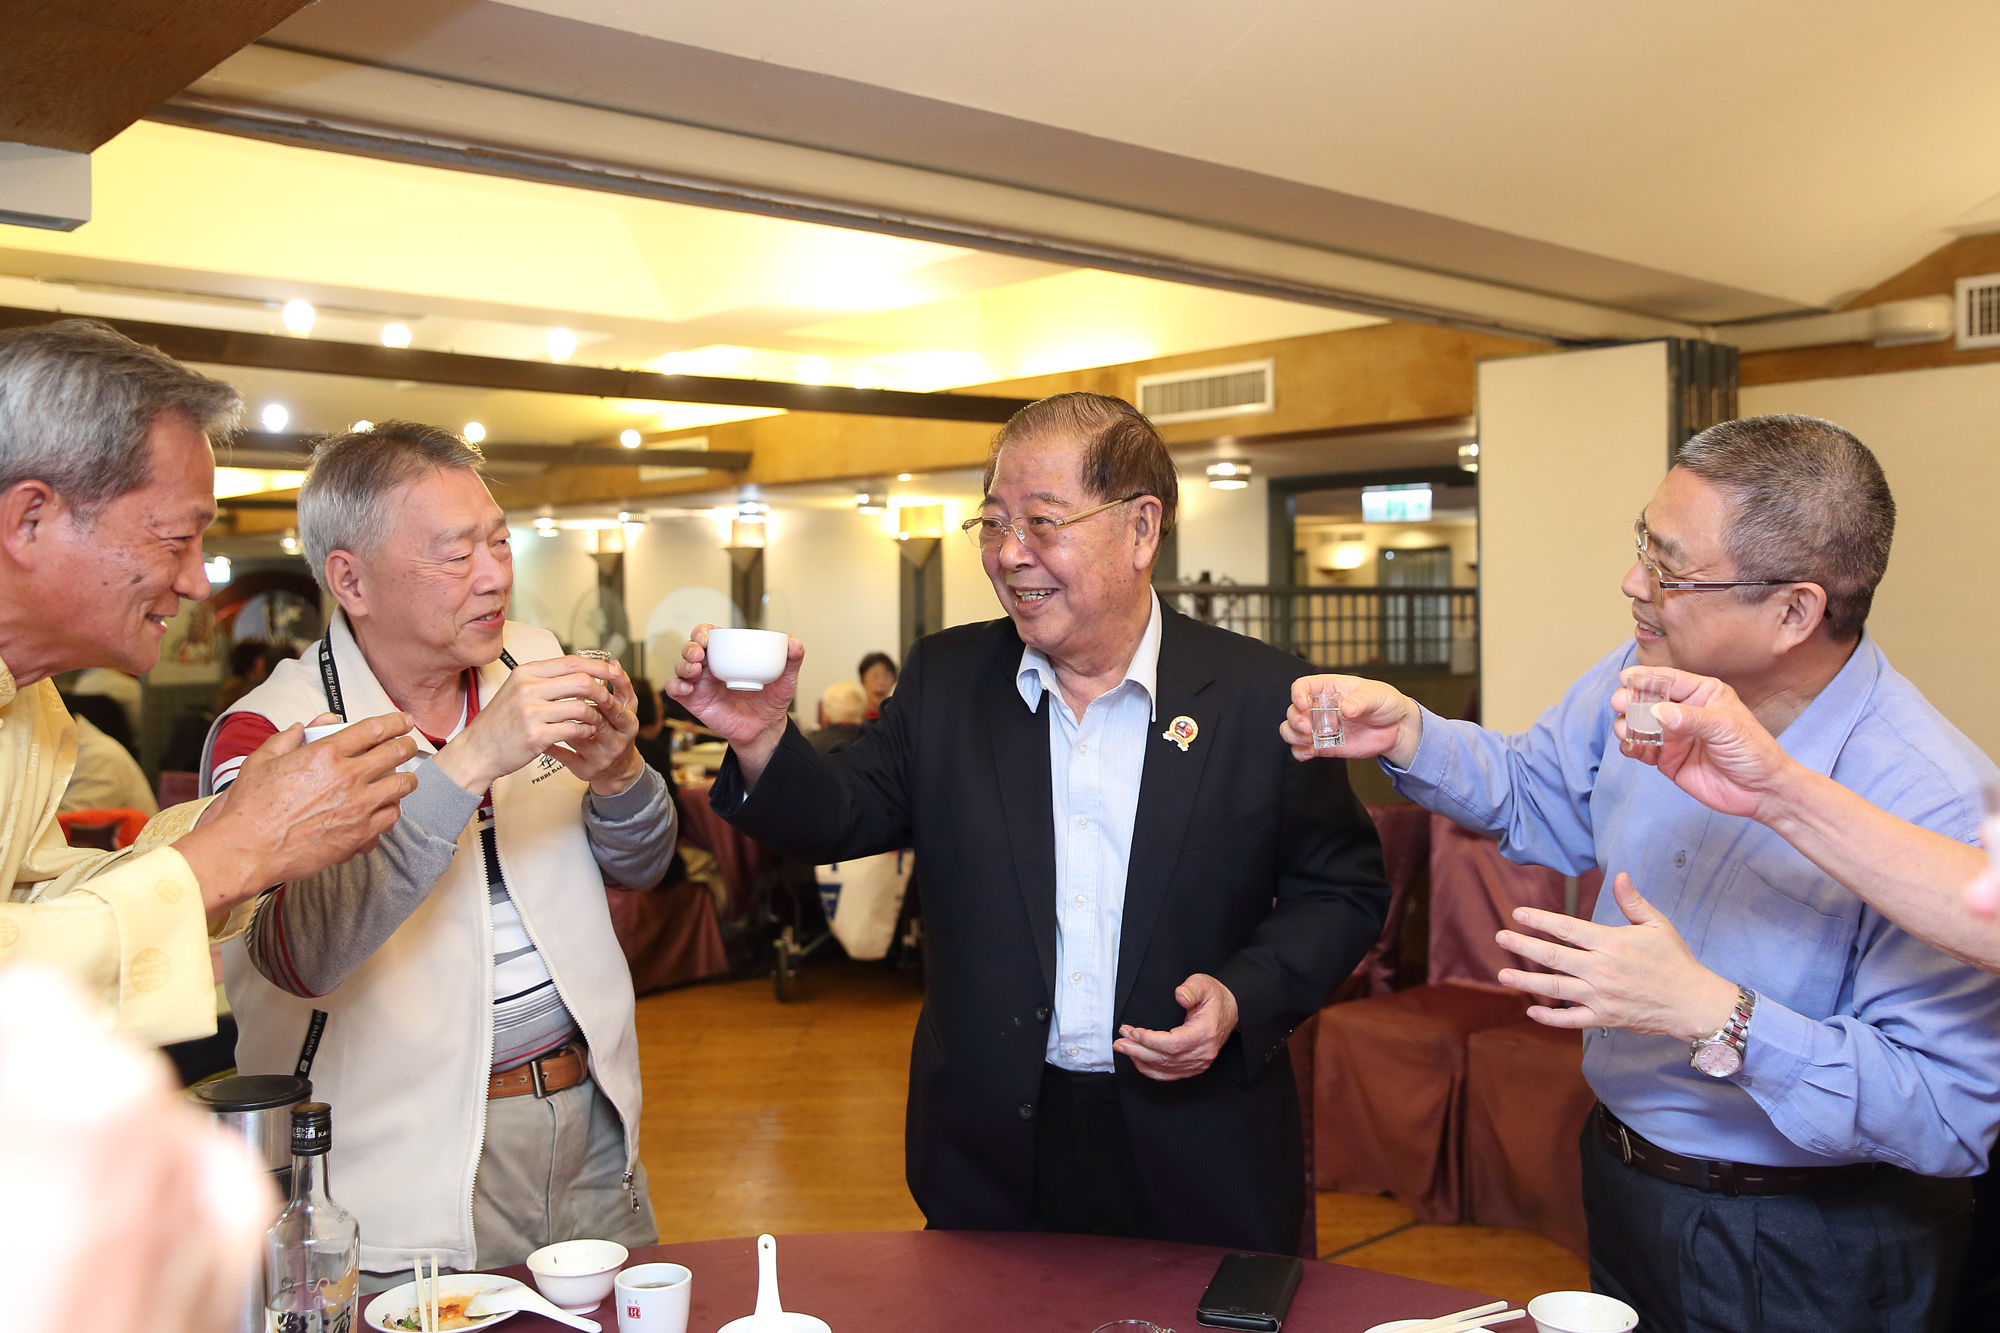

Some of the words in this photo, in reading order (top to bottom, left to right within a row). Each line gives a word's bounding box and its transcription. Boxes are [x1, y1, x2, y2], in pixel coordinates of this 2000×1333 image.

[324, 663, 335, 685] PIERRE
[329, 684, 342, 712] BALMAIN
[305, 1024, 320, 1057] BALMAIN
